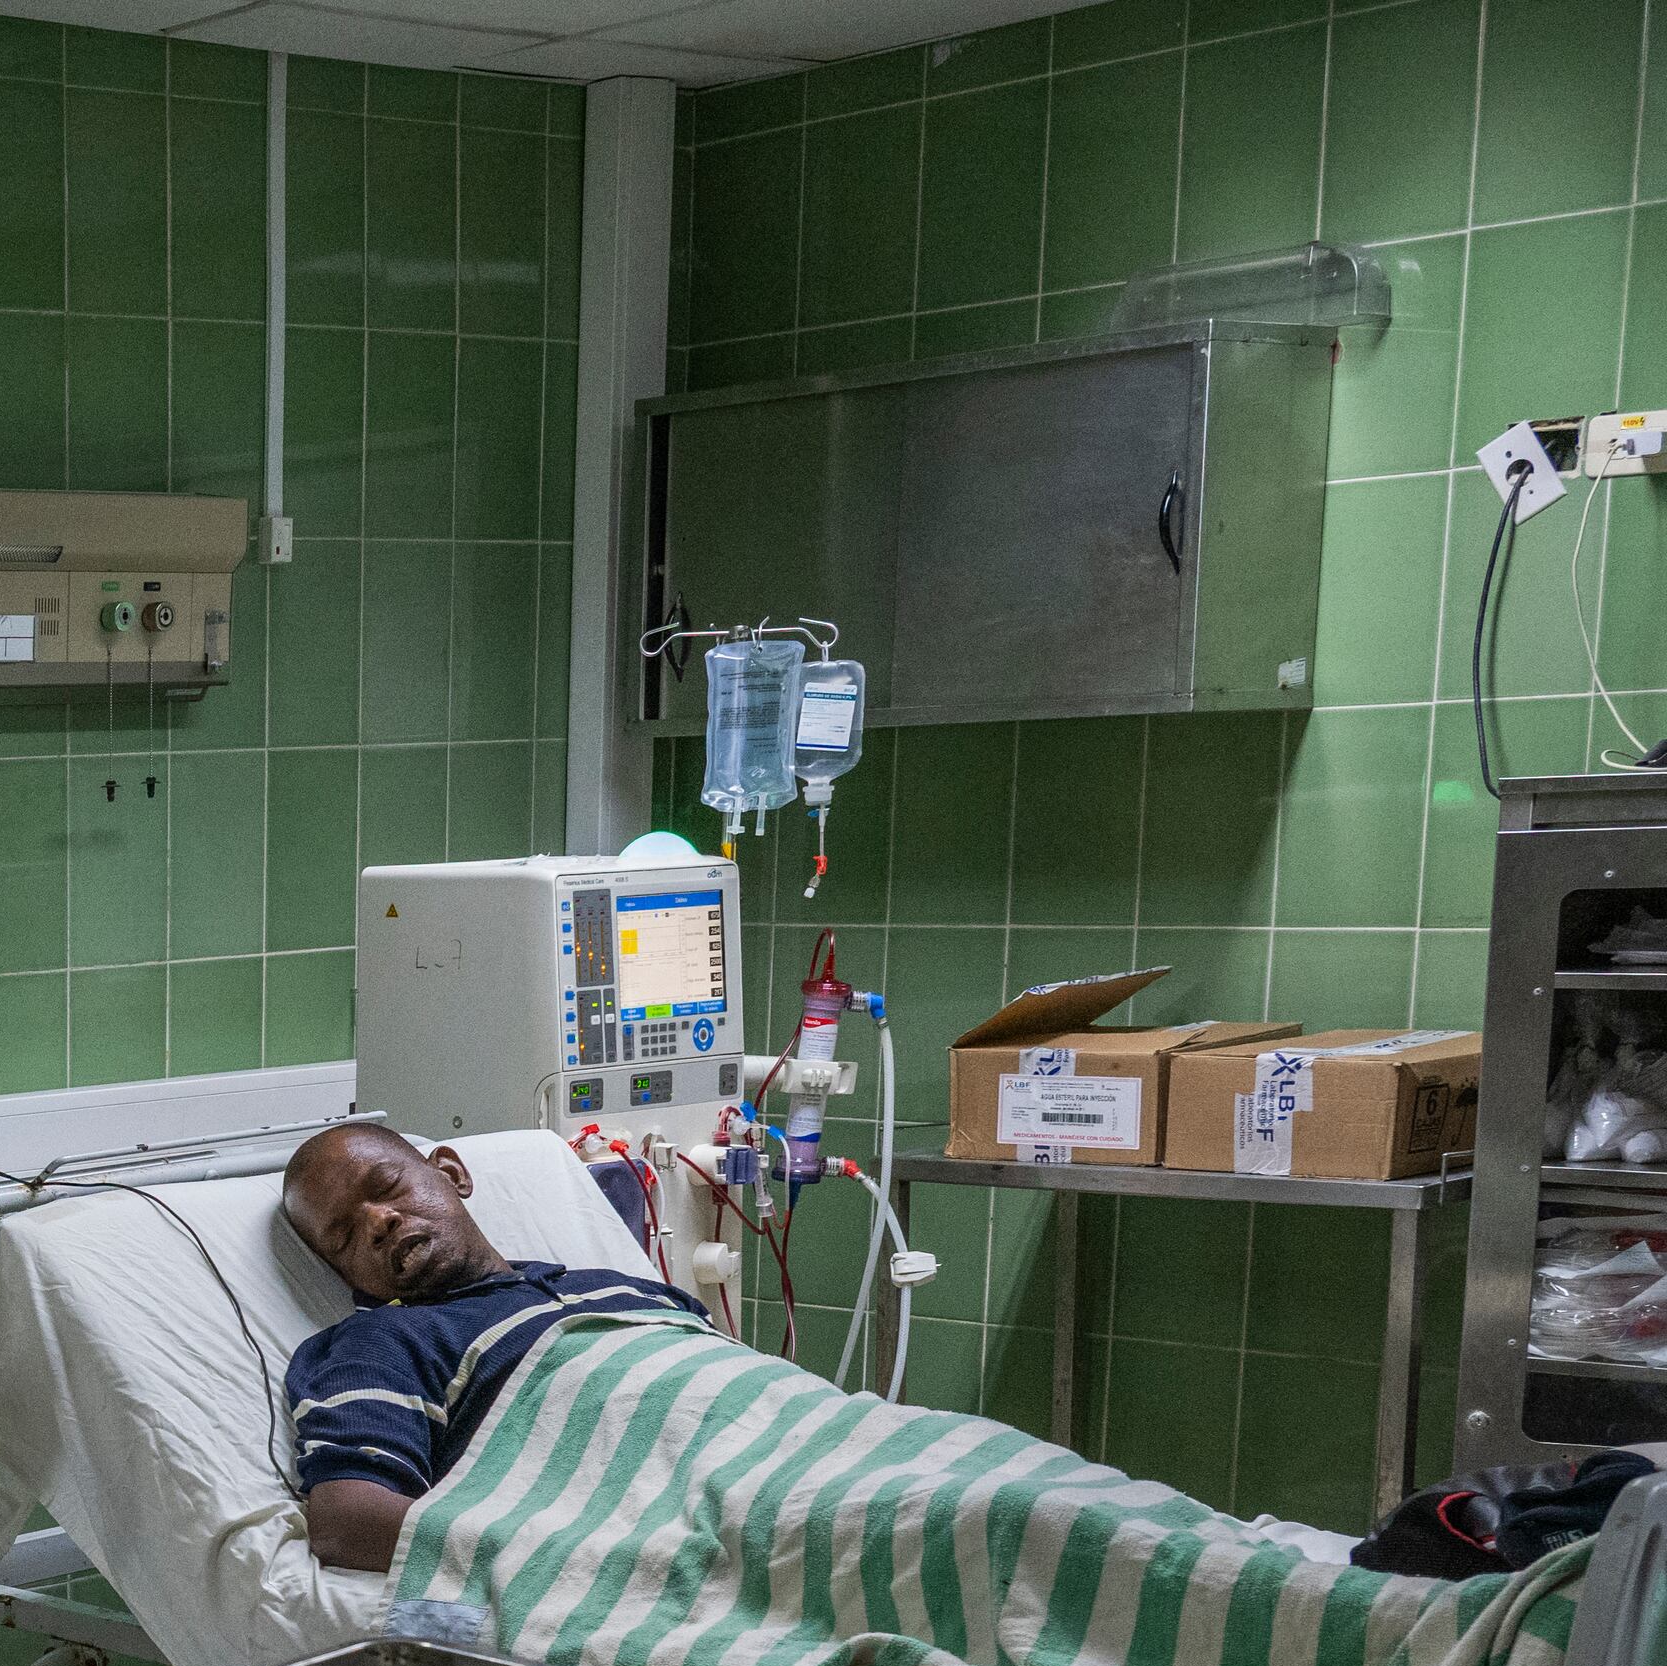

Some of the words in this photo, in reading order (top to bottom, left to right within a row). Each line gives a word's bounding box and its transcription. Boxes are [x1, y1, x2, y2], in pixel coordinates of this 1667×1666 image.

[1014, 1081, 1031, 1089] LBF
[1040, 1093, 1055, 1101] AGUA
[1075, 1094, 1089, 1102] PARA
[1426, 1090, 1439, 1116] 6
[1013, 1131, 1055, 1139] MEDICAMENTOS
[1086, 1134, 1099, 1142] CON
[1099, 1135, 1124, 1143] CUIDADO
